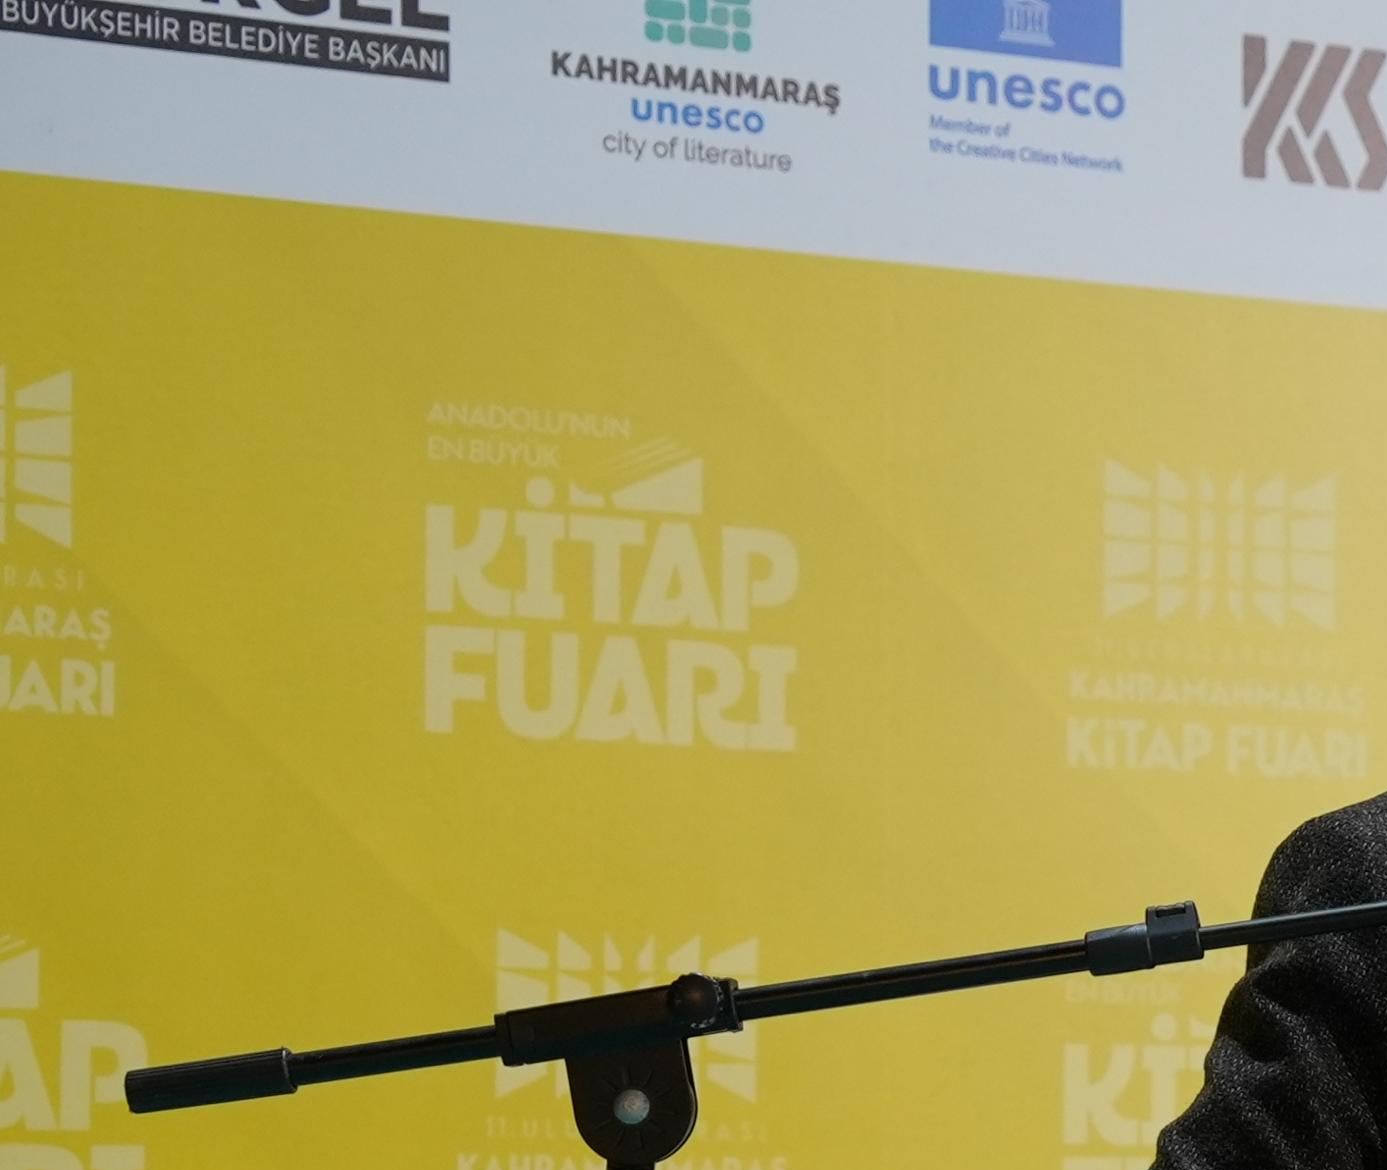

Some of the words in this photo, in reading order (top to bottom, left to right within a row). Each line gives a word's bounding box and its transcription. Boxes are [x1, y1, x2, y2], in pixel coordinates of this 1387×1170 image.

[188, 19, 320, 60] BELEDİYE
[328, 36, 447, 74] BAŞKANI
[550, 50, 842, 116] KAHRAMANMARAŞ
[927, 63, 1127, 119] unesco
[631, 97, 764, 134] unesco
[929, 114, 992, 135] Member
[994, 121, 1012, 138] of
[602, 130, 648, 162] city
[653, 136, 679, 160] of
[684, 137, 793, 173] literature
[929, 137, 954, 154] the
[427, 434, 461, 461] EN
[424, 477, 800, 633] KİTAP
[424, 624, 800, 752] FUARI
[1226, 722, 1368, 778] FUARI
